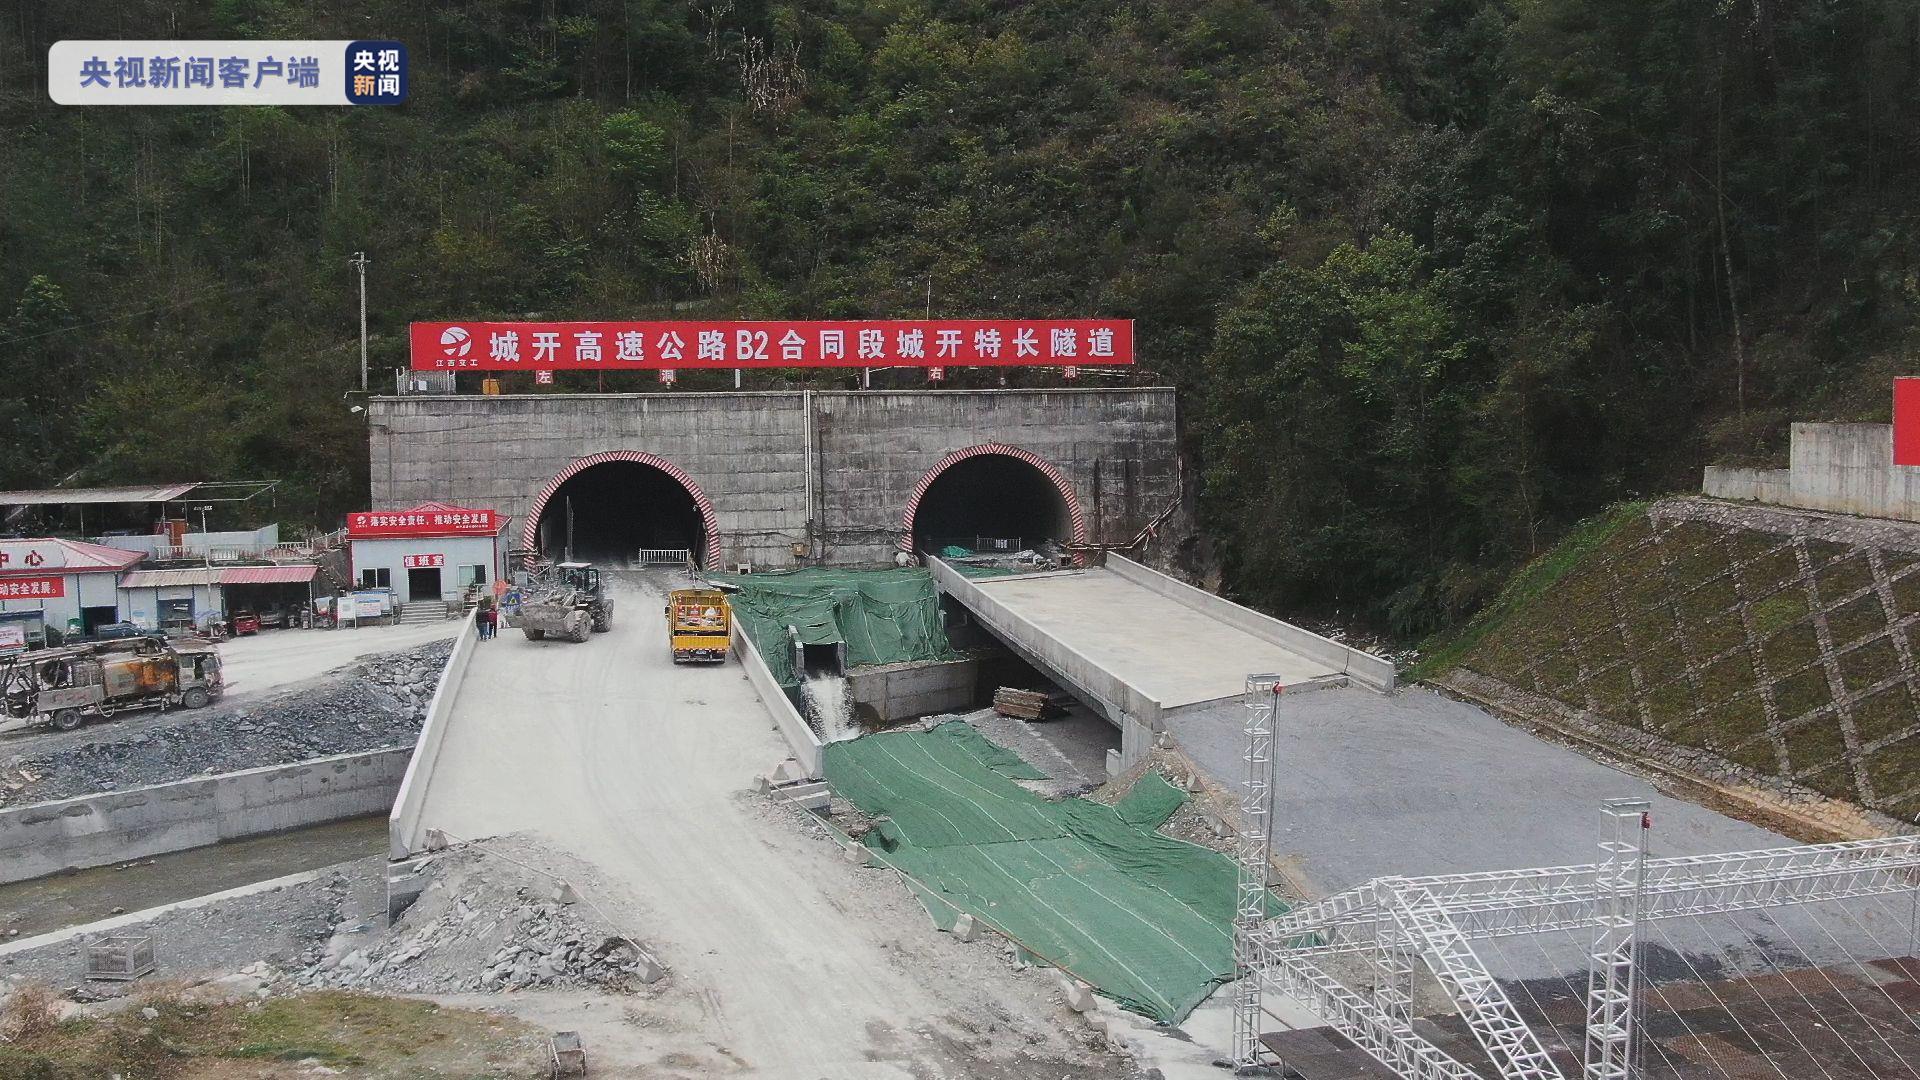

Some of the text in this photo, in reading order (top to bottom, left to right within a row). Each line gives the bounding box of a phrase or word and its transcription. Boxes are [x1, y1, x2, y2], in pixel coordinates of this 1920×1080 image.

[489, 328, 1115, 362] 城开高速公路B2合同段城开特长隧道
[538, 370, 552, 384] 左
[660, 370, 676, 383] 洞
[930, 367, 943, 380] 右
[1064, 365, 1077, 378] 洞
[404, 555, 444, 567] 值班室
